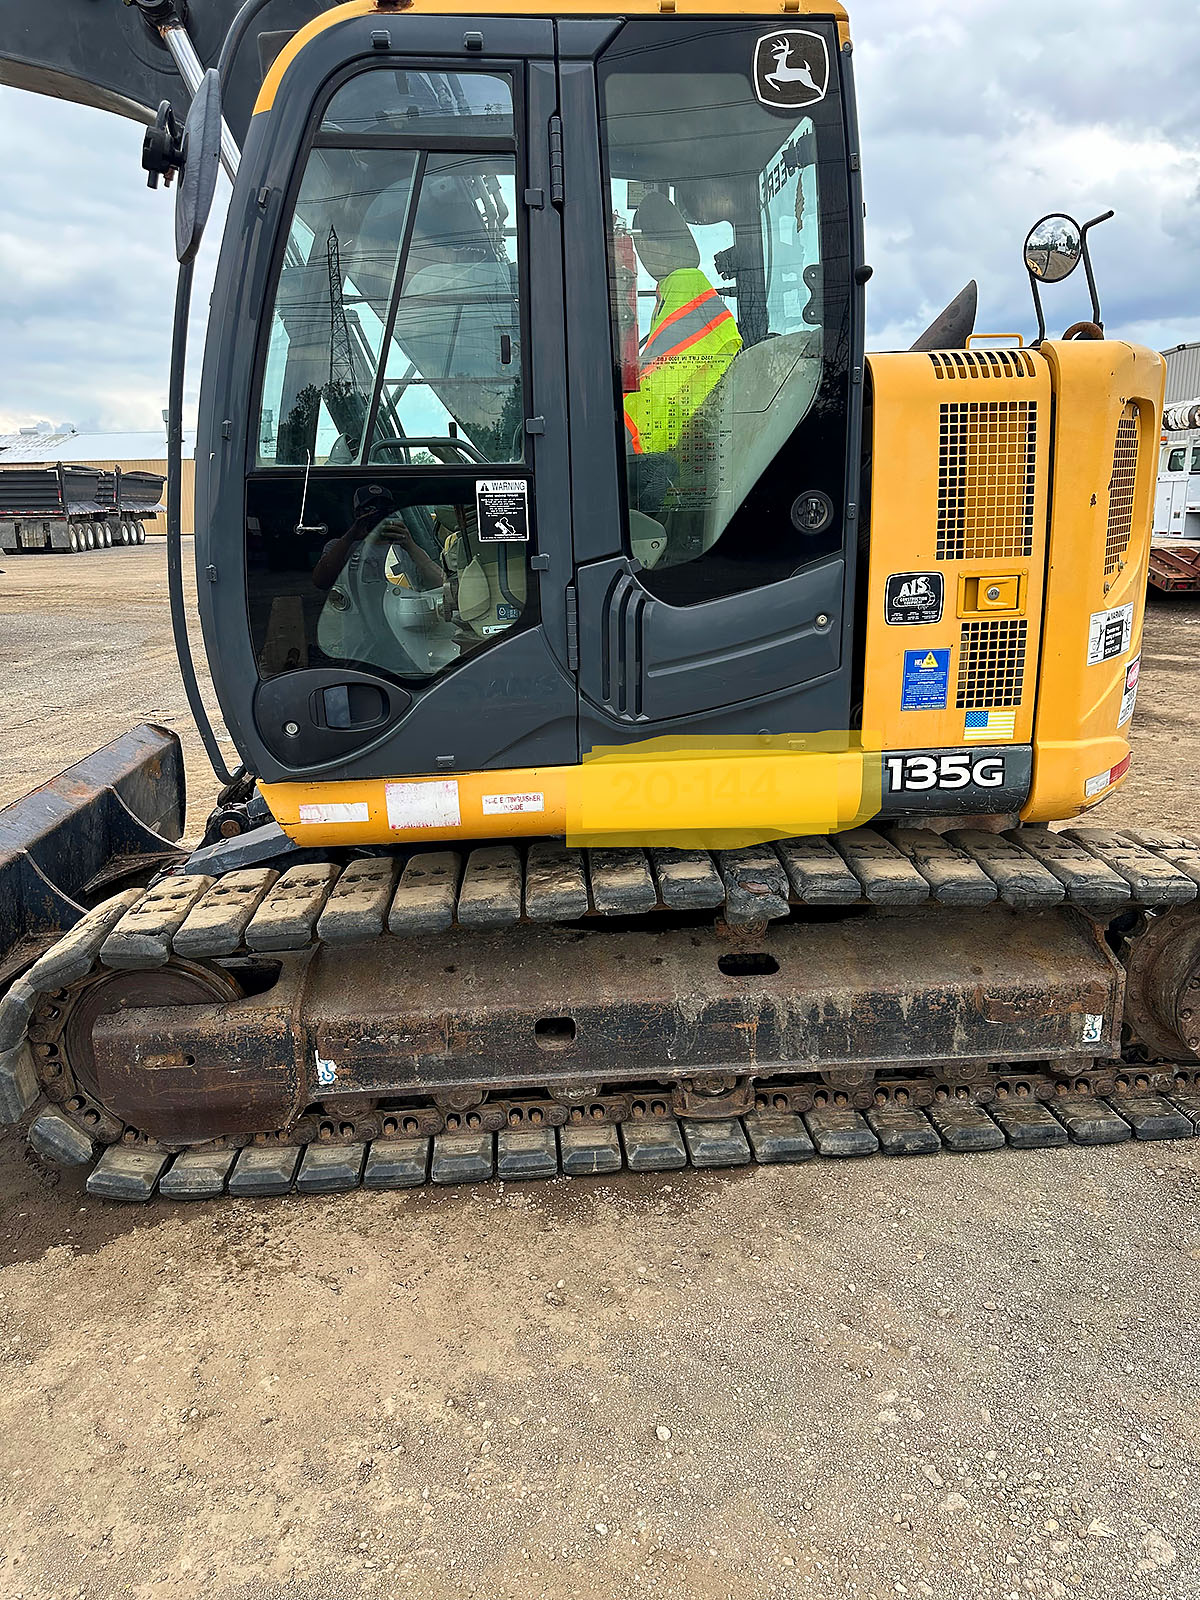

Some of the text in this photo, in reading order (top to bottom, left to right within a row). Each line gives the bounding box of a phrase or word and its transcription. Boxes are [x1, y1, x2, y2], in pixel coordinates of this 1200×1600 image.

[492, 481, 525, 491] WARNING
[899, 577, 928, 597] AIS
[887, 754, 1004, 791] 135G
[499, 795, 541, 803] ETINGUISHER
